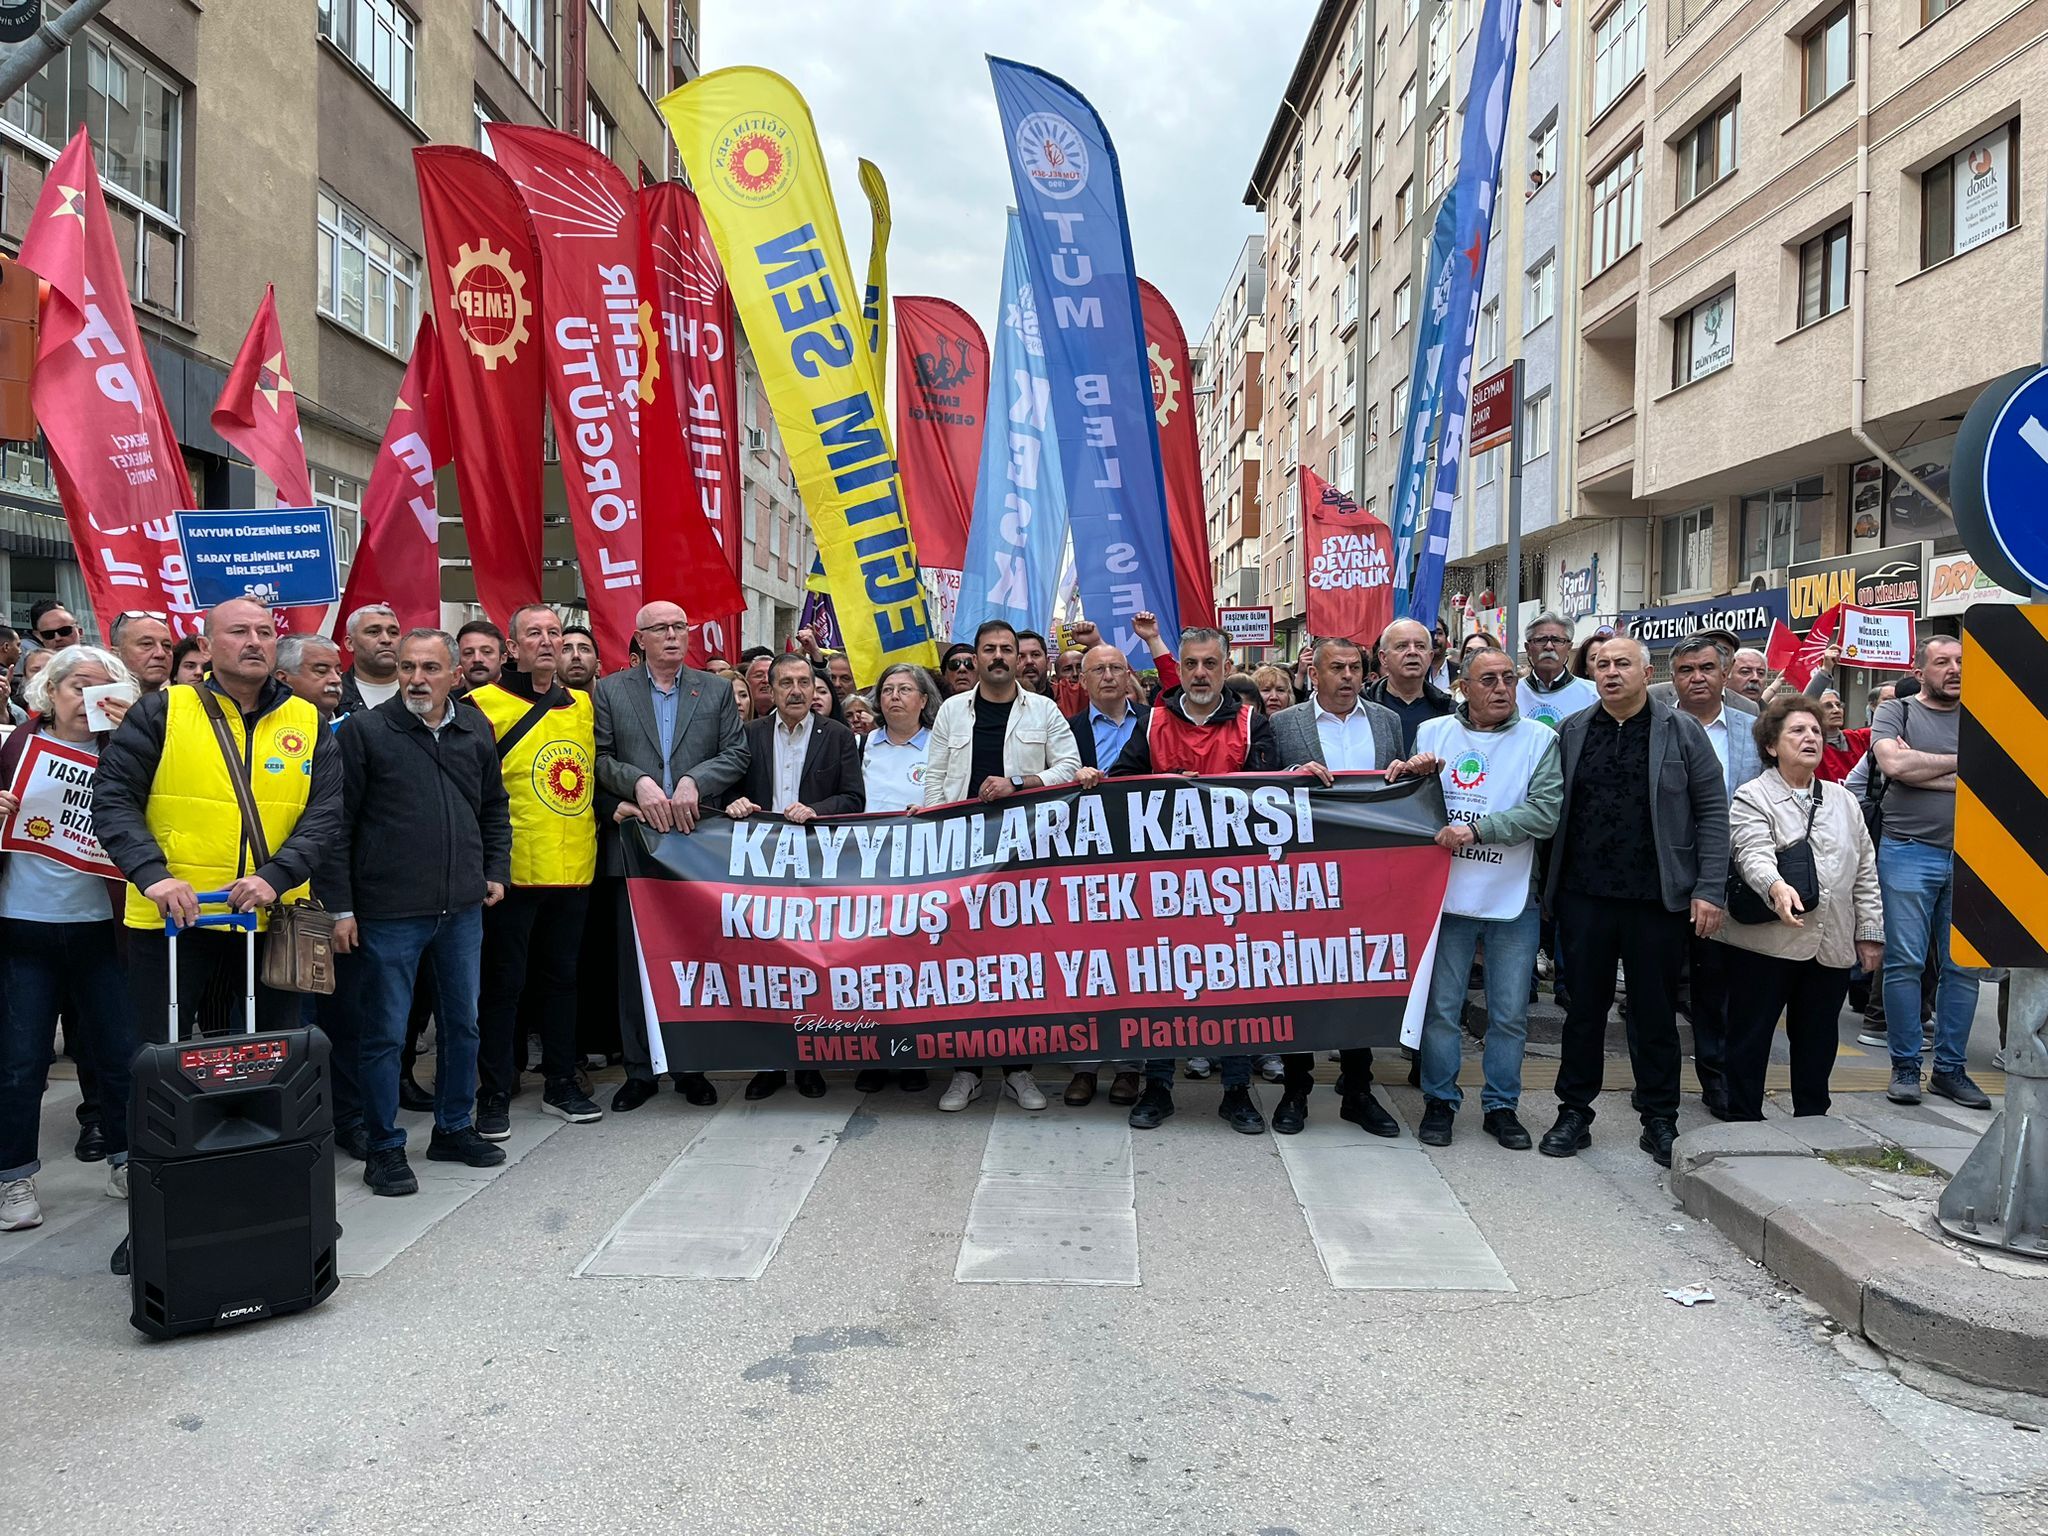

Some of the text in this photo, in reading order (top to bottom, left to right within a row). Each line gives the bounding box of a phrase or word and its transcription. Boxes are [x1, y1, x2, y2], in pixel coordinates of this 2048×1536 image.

[1473, 378, 1505, 407] SÜLEYMAN
[1472, 406, 1491, 429] ÇAKIR
[188, 524, 321, 538] KAYYUM DÜZENİNE SON!
[196, 549, 320, 563] SARAY REJİMİNE KARŞI
[1322, 533, 1376, 555] İSYAN
[226, 563, 294, 576] BİRLEŞELİM!
[1313, 548, 1386, 572] DEVRİM
[244, 583, 279, 597] SOL
[1309, 566, 1391, 590] ÖZGÜRLÜK
[1564, 572, 1586, 594] Parti
[1564, 593, 1591, 617] Diyarı
[1790, 568, 1856, 619] UZMAN
[1858, 587, 1874, 605] OTO
[1643, 606, 1767, 640] ÖZTEKİN SİGORTA
[537, 745, 572, 771] EĞİTİM
[63, 828, 97, 849] EMEK
[728, 786, 1314, 878] KAYYIMLARA KARŞI
[721, 861, 1341, 944] KURTULUŞ YOK TEK BAŞINA!
[670, 927, 1408, 1011] YA HEP BERABER! YA HİÇBİRİMİZ!
[792, 1013, 881, 1032] Eskişehir
[797, 1015, 1295, 1062] EMEK Ve DEMOKRASİ Platformu
[221, 1304, 264, 1319] KORAX
